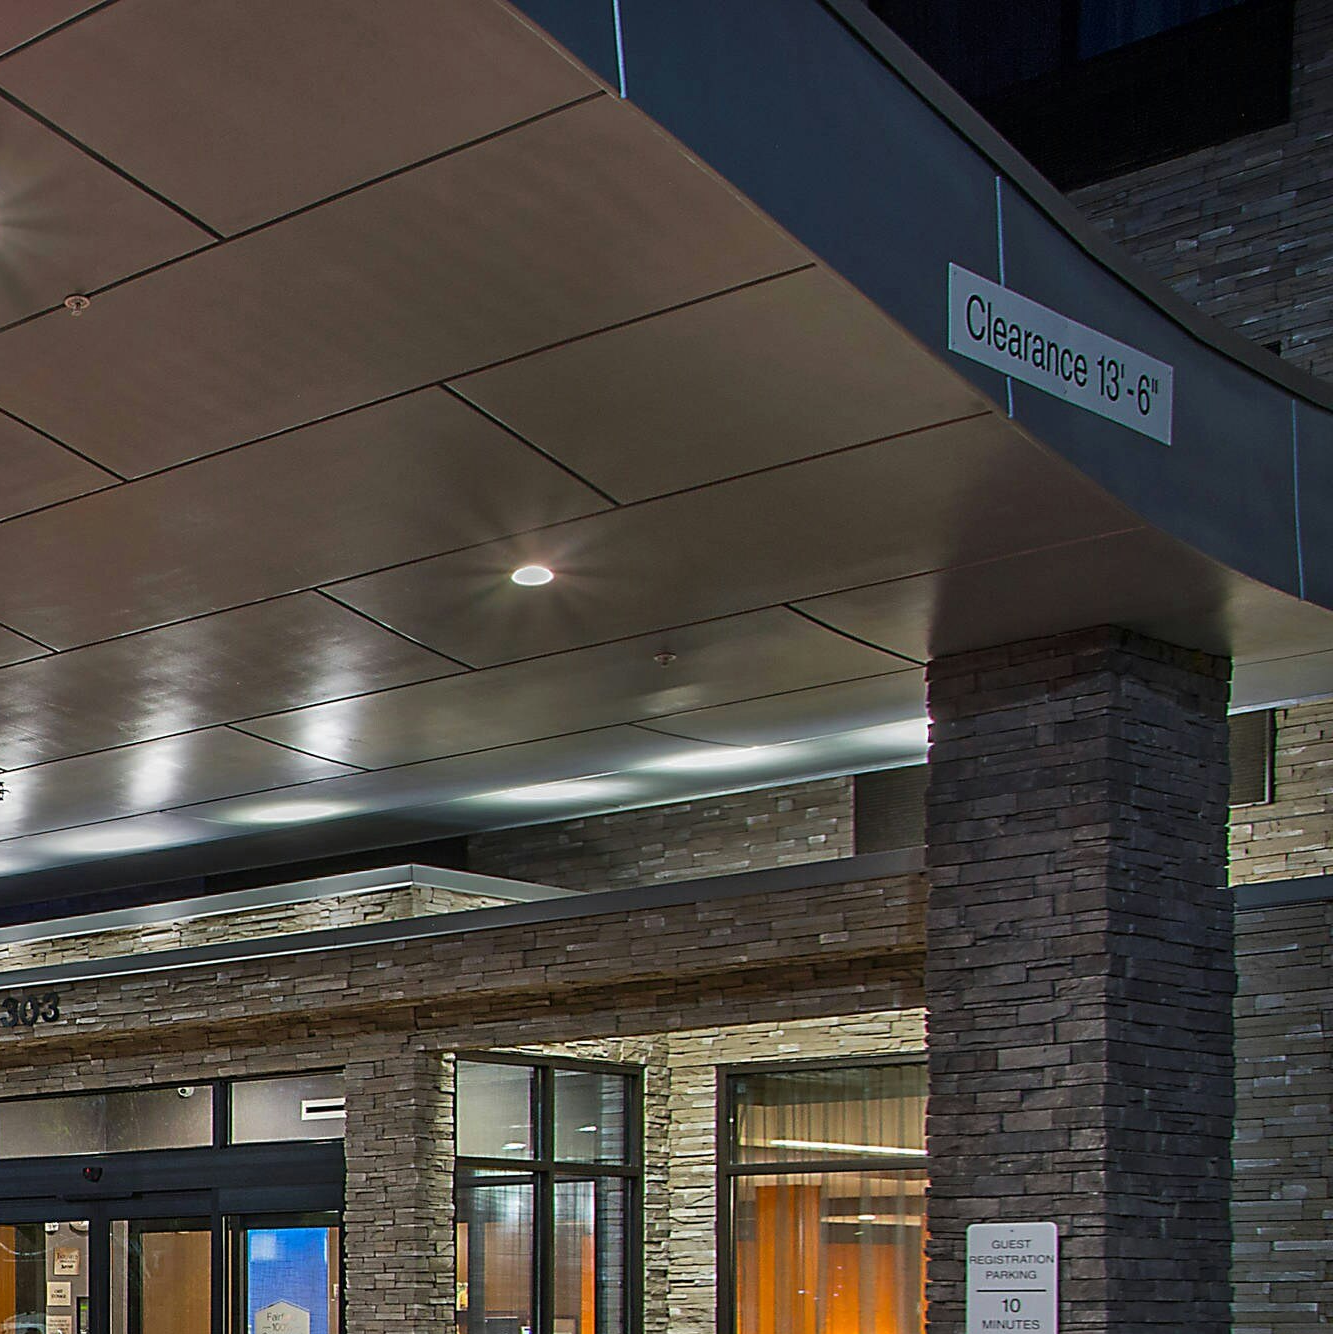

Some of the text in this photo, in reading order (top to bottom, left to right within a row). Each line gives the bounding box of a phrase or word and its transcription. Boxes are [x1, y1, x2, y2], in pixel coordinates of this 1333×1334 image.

[966, 294, 1159, 416] Clearance 13'-6"
[1, 992, 60, 1027] 303
[991, 1239, 1032, 1249] GUEST
[969, 1254, 1055, 1265] REGISTRATION
[985, 1270, 1037, 1280] PARKING
[1001, 1298, 1021, 1313] 10
[981, 1319, 1040, 1330] MINUTES
